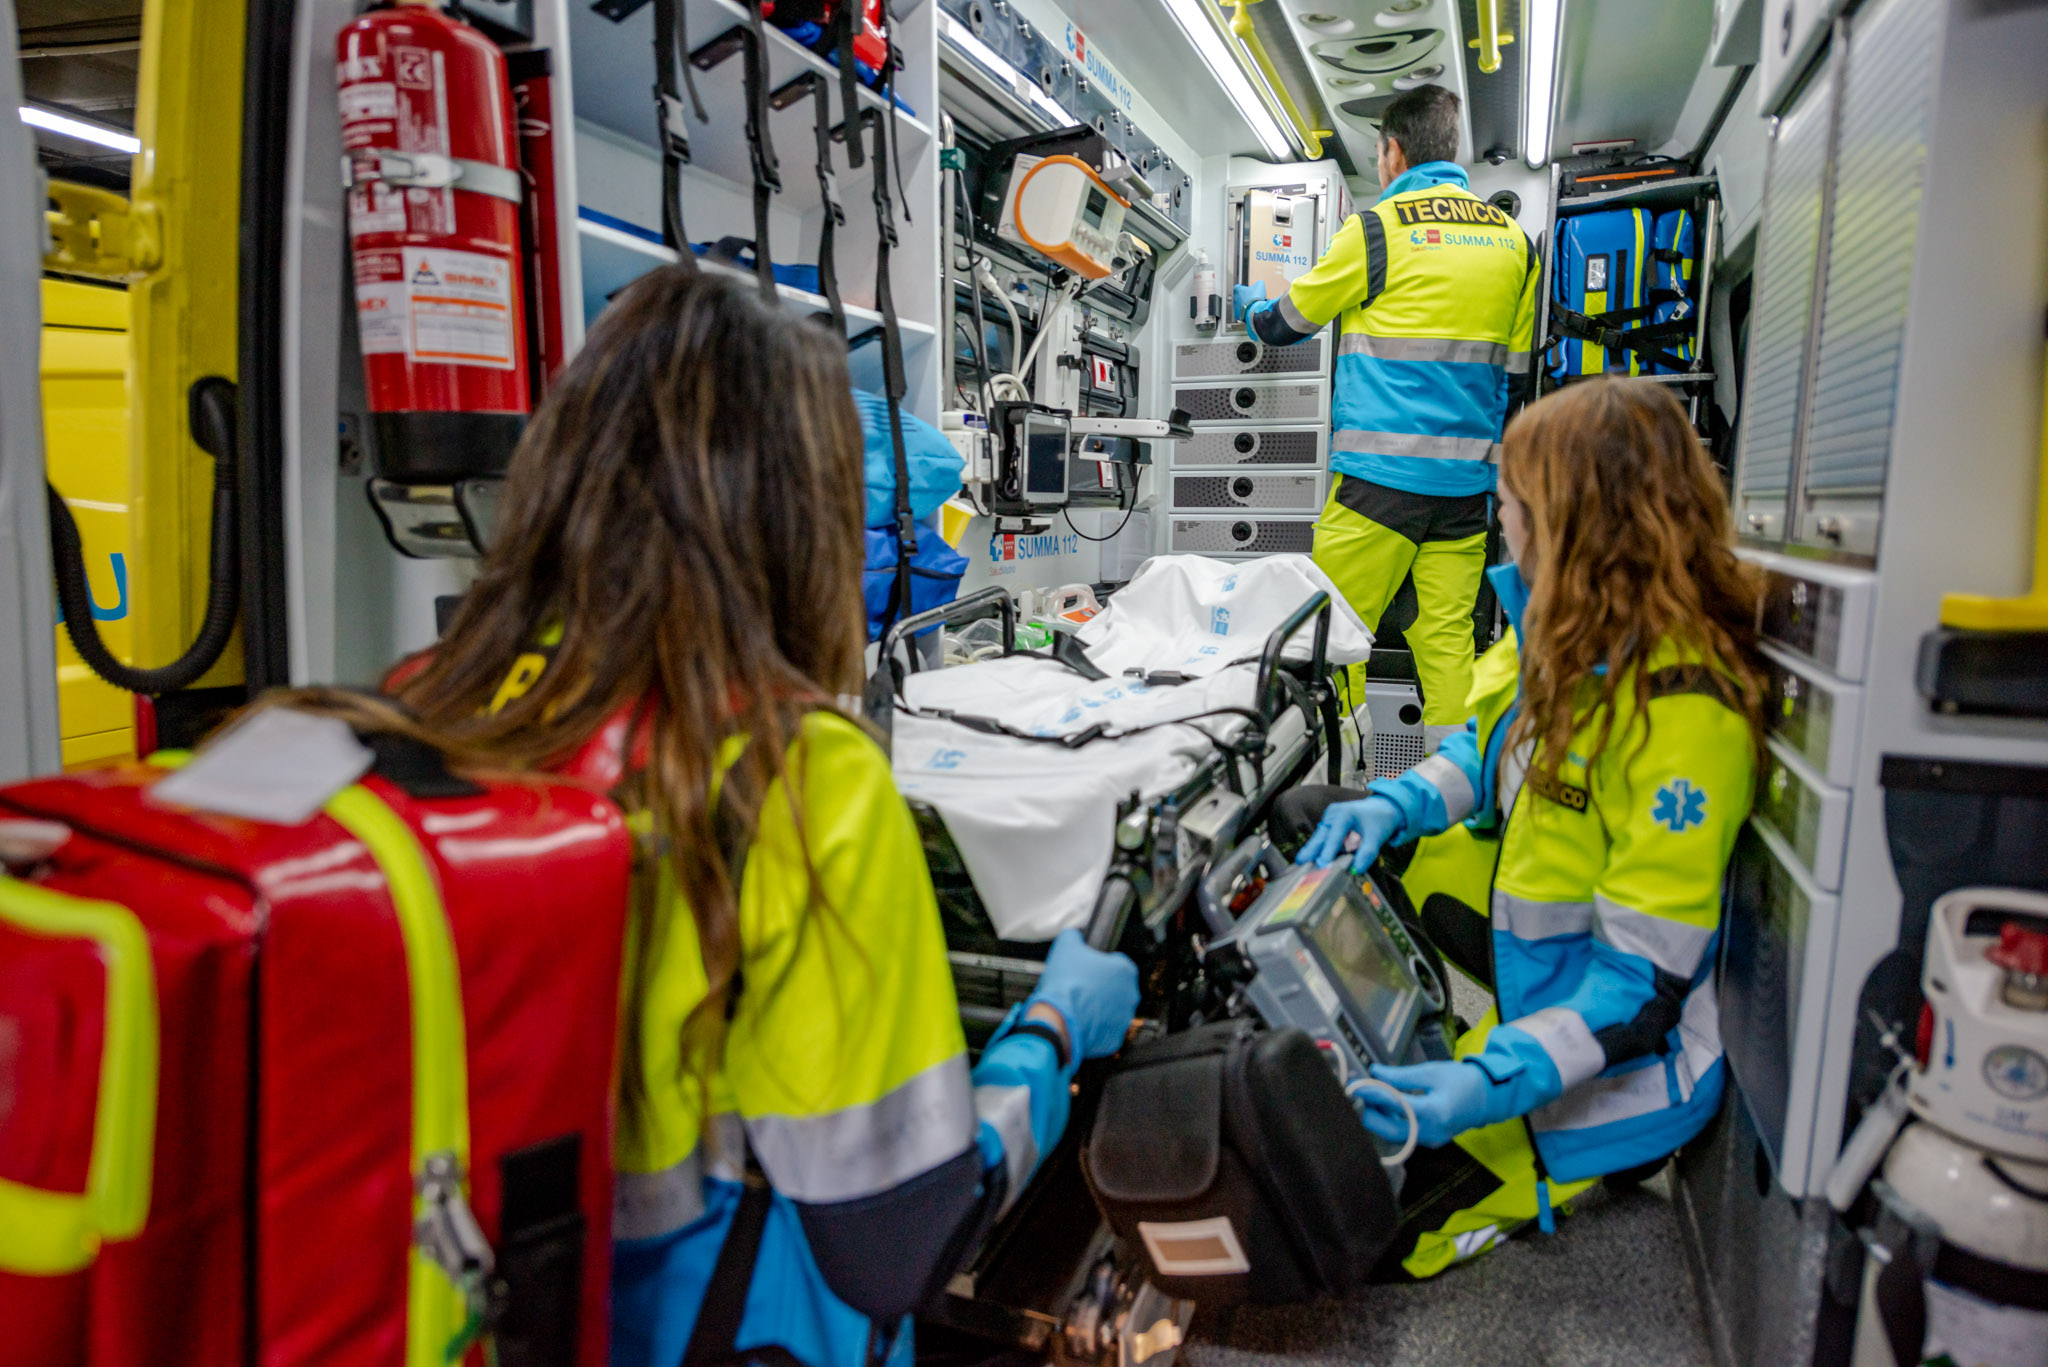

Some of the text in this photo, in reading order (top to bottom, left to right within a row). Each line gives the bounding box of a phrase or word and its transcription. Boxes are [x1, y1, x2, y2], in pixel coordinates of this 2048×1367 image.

[1086, 49, 1131, 111] SUMMA 112
[1397, 198, 1505, 224] TECNICO
[1444, 233, 1516, 250] SUMMA 112
[1256, 251, 1307, 266] SUMMA 112
[1018, 534, 1078, 560] SUMMA 112
